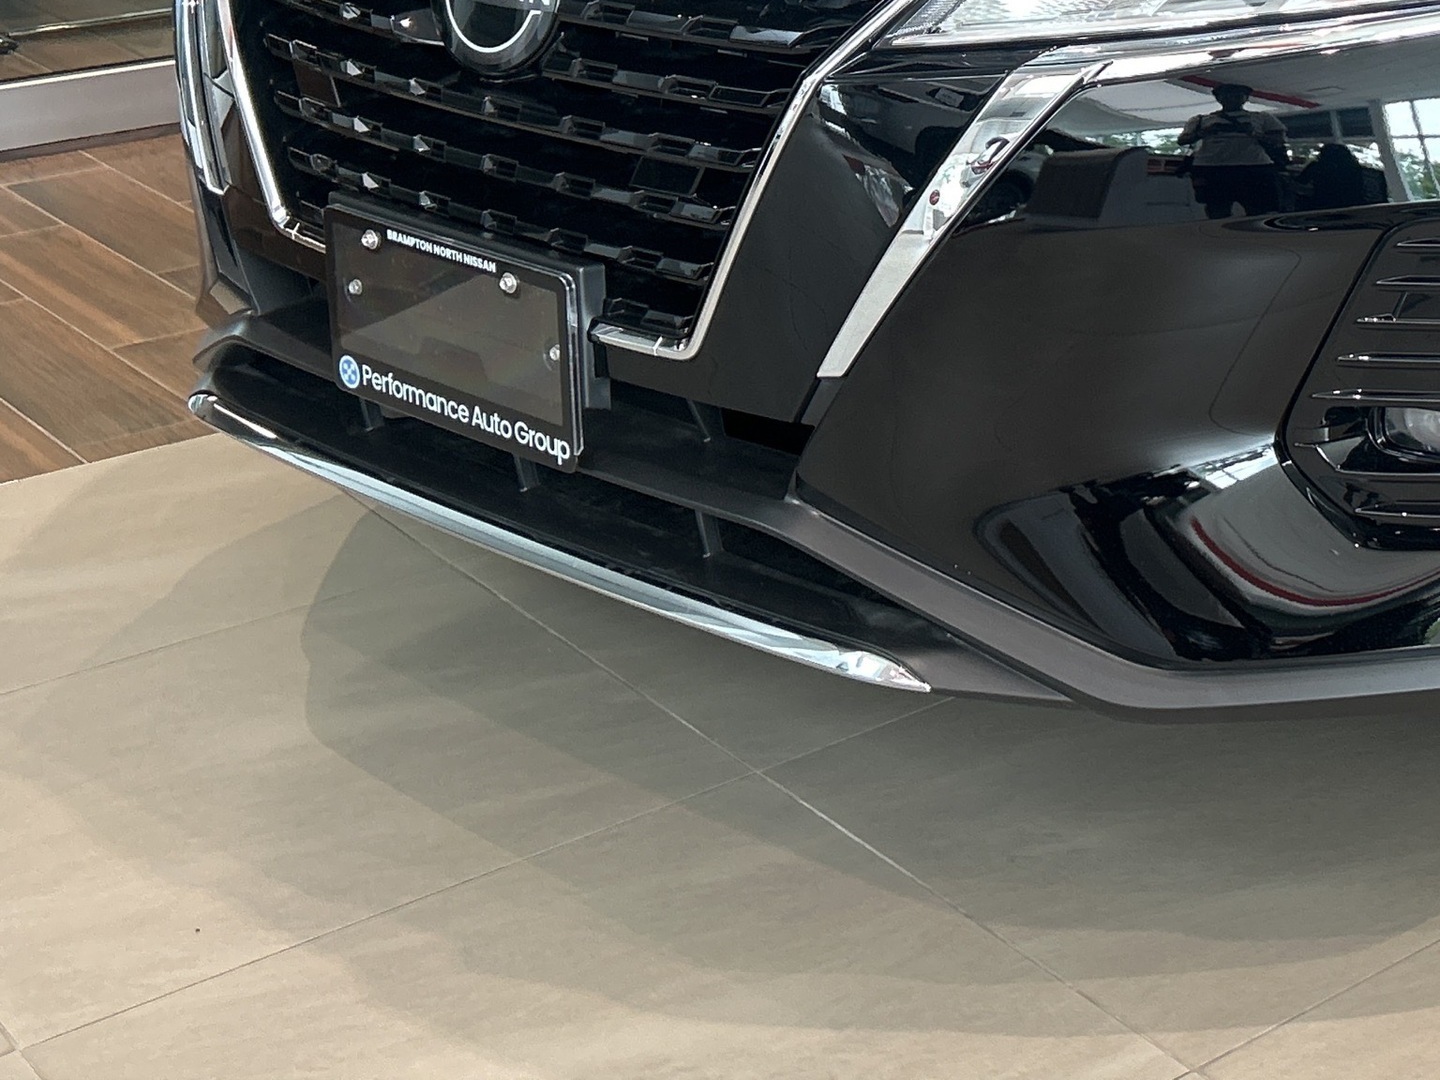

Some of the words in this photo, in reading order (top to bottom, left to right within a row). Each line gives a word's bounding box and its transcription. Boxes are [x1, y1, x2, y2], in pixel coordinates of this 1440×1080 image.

[386, 229, 433, 254] BRAMPTON
[433, 244, 463, 263] NORTH
[463, 253, 497, 273] NISSAN
[362, 364, 470, 424] Performance
[472, 405, 512, 439] Auto
[514, 421, 571, 465] Group
